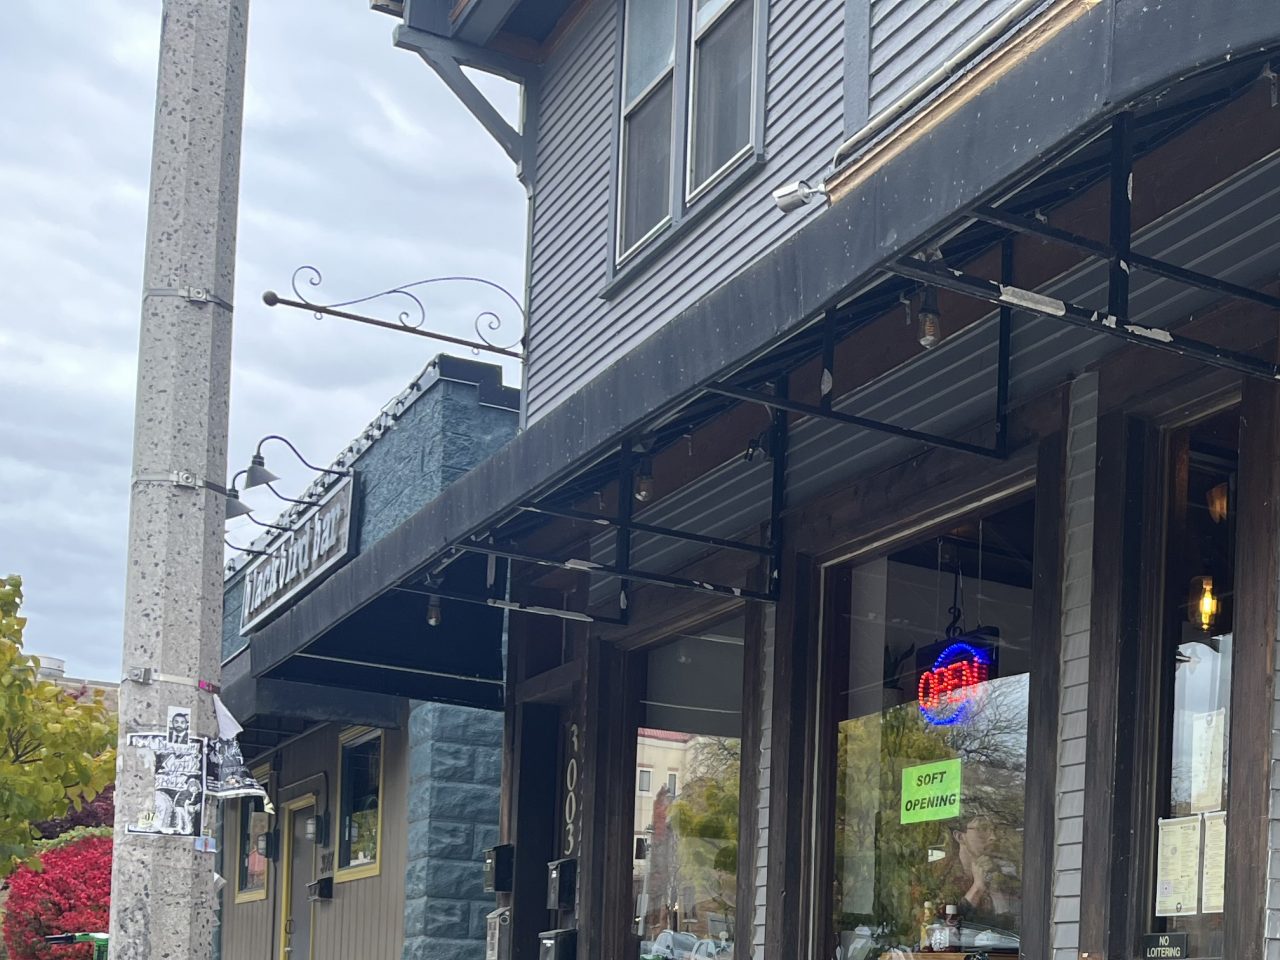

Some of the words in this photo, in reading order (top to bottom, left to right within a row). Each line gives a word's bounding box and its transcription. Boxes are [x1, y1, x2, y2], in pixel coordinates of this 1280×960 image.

[918, 657, 980, 708] OPEN
[916, 771, 947, 787] SOFT
[905, 793, 957, 812] OPENING
[1159, 935, 1170, 946] NO
[1146, 946, 1181, 958] LOITERING
